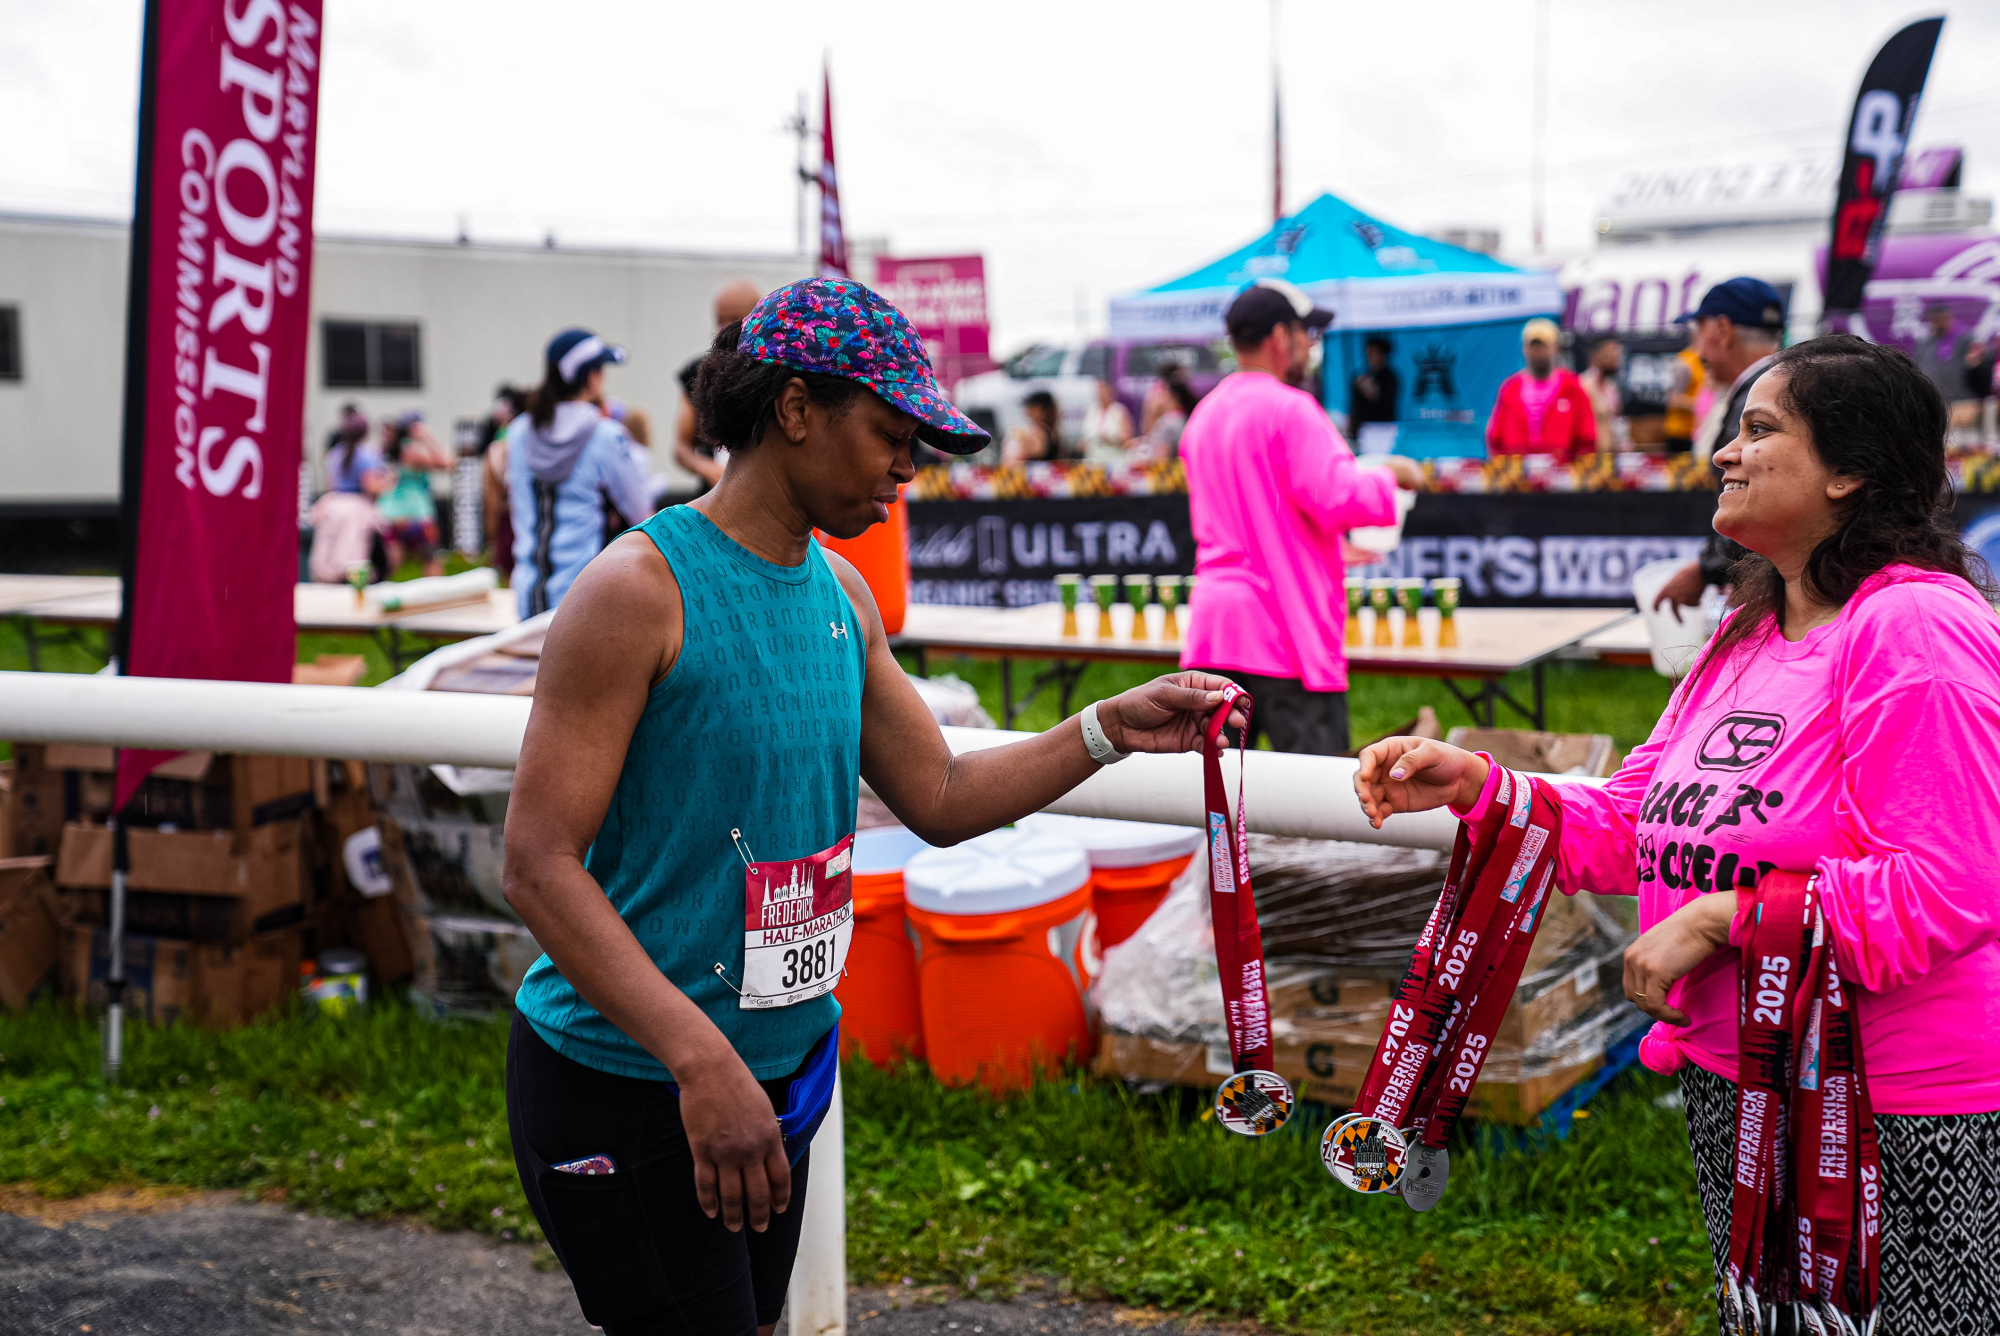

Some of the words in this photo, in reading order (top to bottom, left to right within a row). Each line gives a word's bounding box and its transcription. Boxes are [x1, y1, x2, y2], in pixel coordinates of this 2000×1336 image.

[275, 2, 321, 298] MARYLAND
[200, 0, 287, 500] SPORTS
[174, 128, 216, 490] COMMISSION
[1011, 521, 1178, 567] ULTRA
[1514, 827, 1537, 868] FREDERICK
[1514, 860, 1528, 881] FOOT
[1525, 852, 1532, 862] &
[1529, 830, 1544, 854] ANKLE
[761, 897, 815, 928] FREDERICK
[762, 904, 851, 946] HALF-MARATHON
[782, 933, 836, 989] 3881
[1438, 929, 1479, 991] 2025
[1753, 955, 1791, 1026] 2025
[756, 997, 774, 1005] Giant
[1248, 958, 1268, 1048] FREDERICK
[1371, 1039, 1422, 1121] FREDERICK
[1397, 1044, 1430, 1102] MARATHON
[1449, 1032, 1488, 1093] 2025
[1737, 1088, 1759, 1185] FREDERICK
[1750, 1091, 1768, 1158] MARATHON
[1818, 1076, 1838, 1178] FREDERICK
[1833, 1075, 1847, 1139] MARATHON
[1351, 1178, 1368, 1188] 2025
[1354, 1152, 1386, 1163] FREDERICK
[1746, 1157, 1758, 1189] HALF
[1835, 1140, 1848, 1179] HALF
[1859, 1163, 1881, 1238] 2025
[1797, 1215, 1814, 1290] 2025
[1818, 1253, 1840, 1301] FRED
